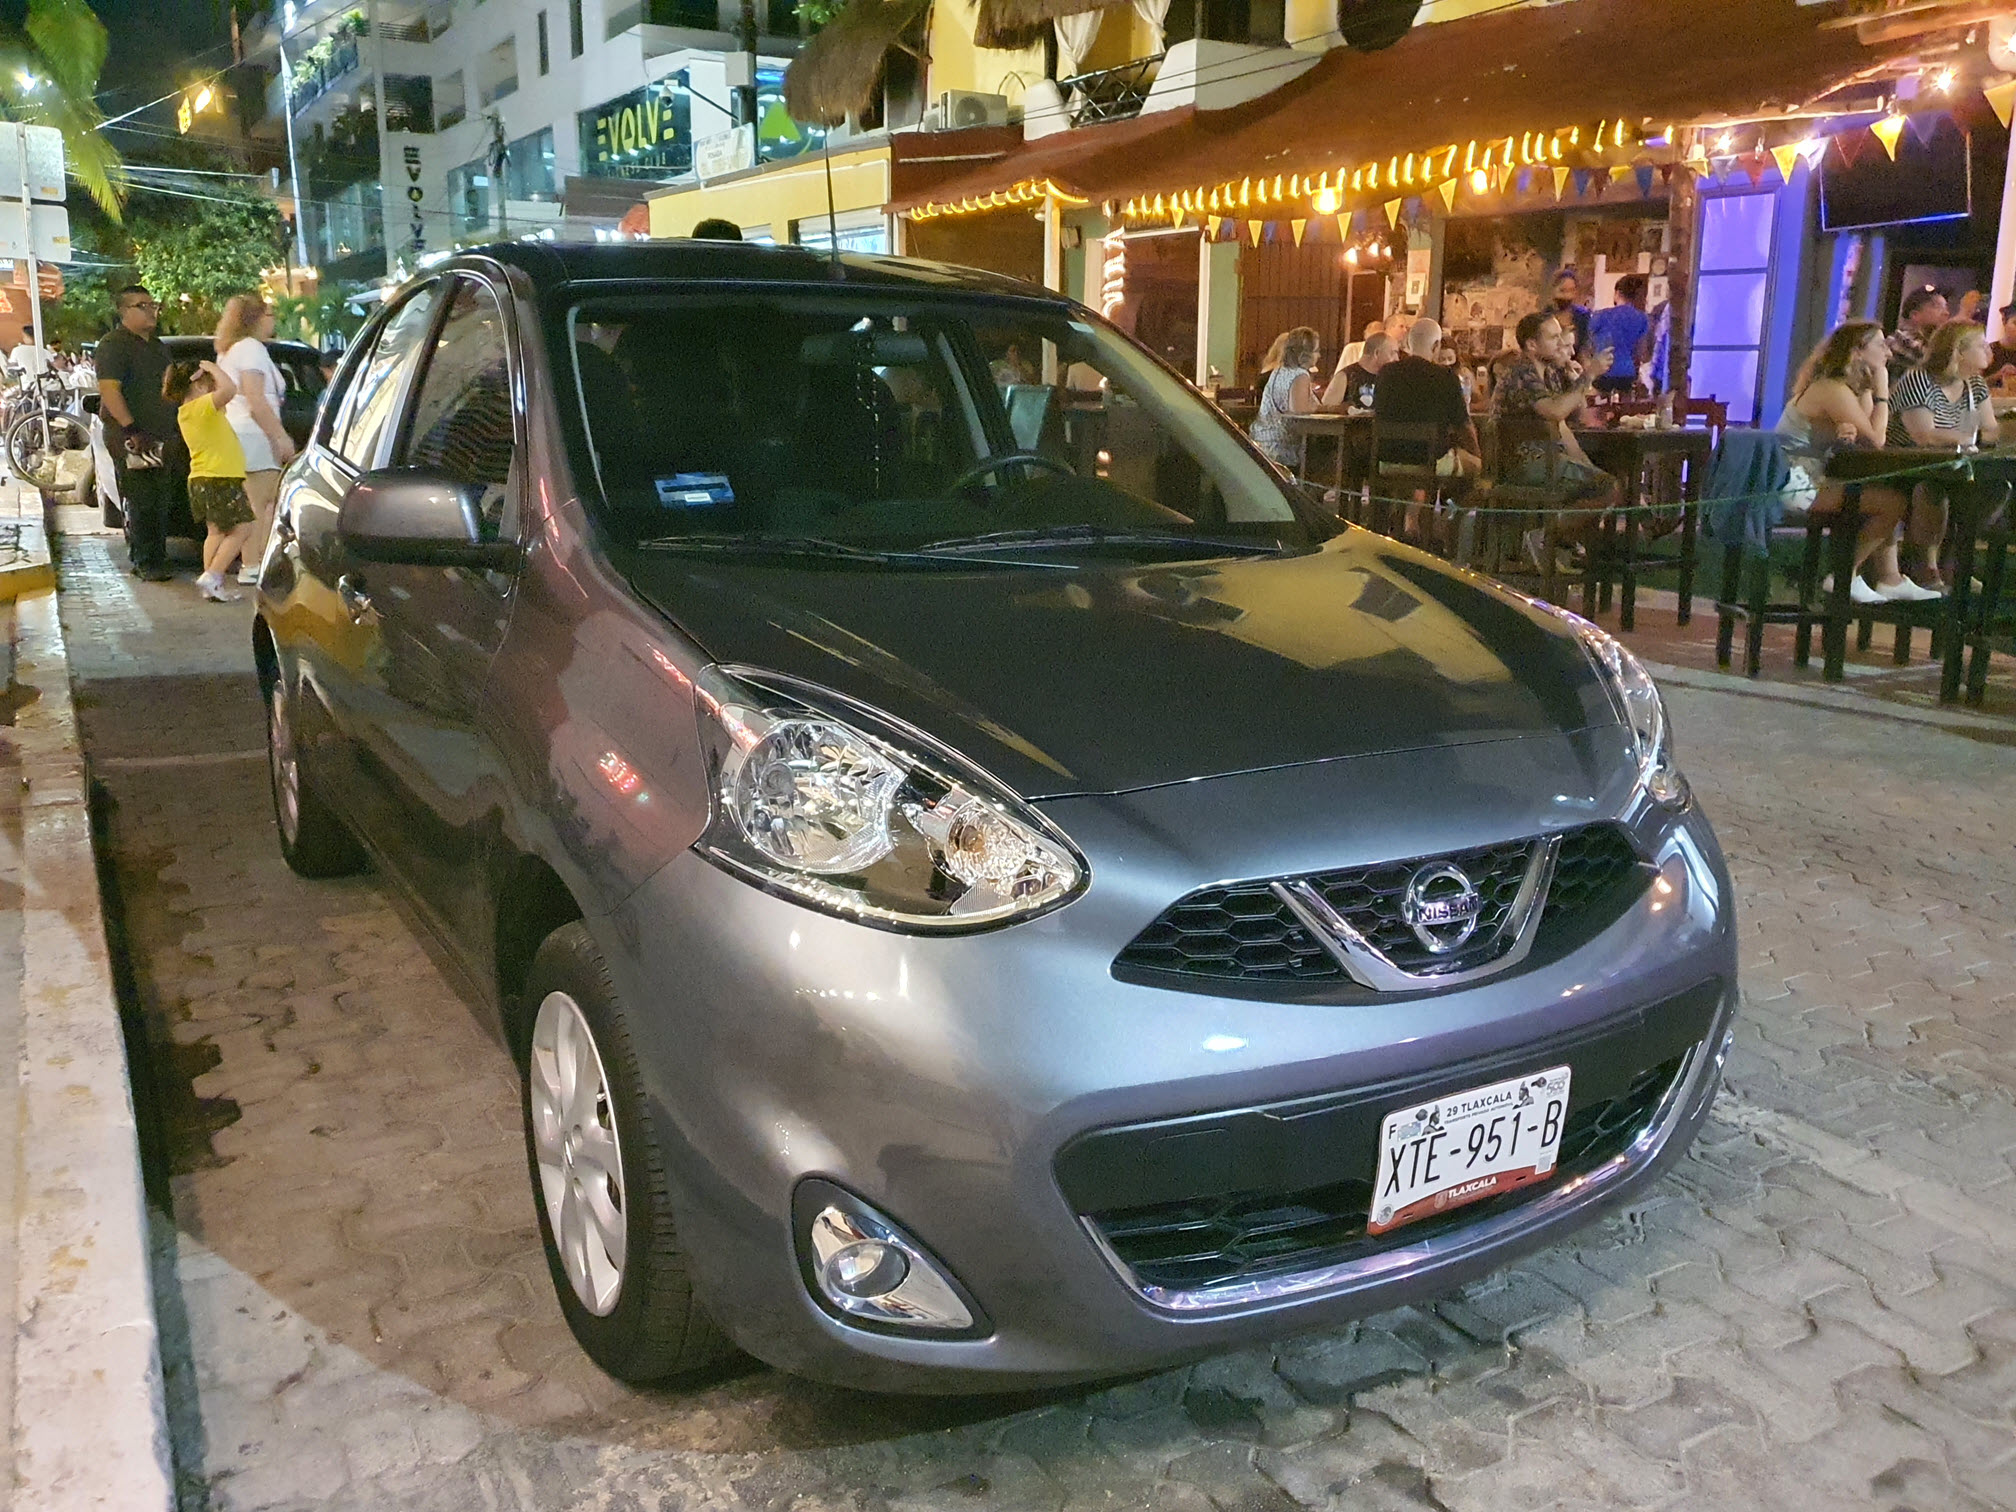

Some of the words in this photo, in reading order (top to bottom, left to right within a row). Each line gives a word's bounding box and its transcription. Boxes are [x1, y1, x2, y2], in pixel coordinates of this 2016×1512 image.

[597, 96, 675, 161] EVOLVE
[403, 147, 426, 250] EVOLVE
[1418, 895, 1479, 921] NISSAN
[1446, 1105, 1459, 1117] 29
[1461, 1091, 1512, 1113] TLAXCALA
[1388, 1123, 1398, 1140] F
[1384, 1099, 1563, 1198] XTE-951-B
[1448, 1176, 1497, 1199] TLAXCALA
